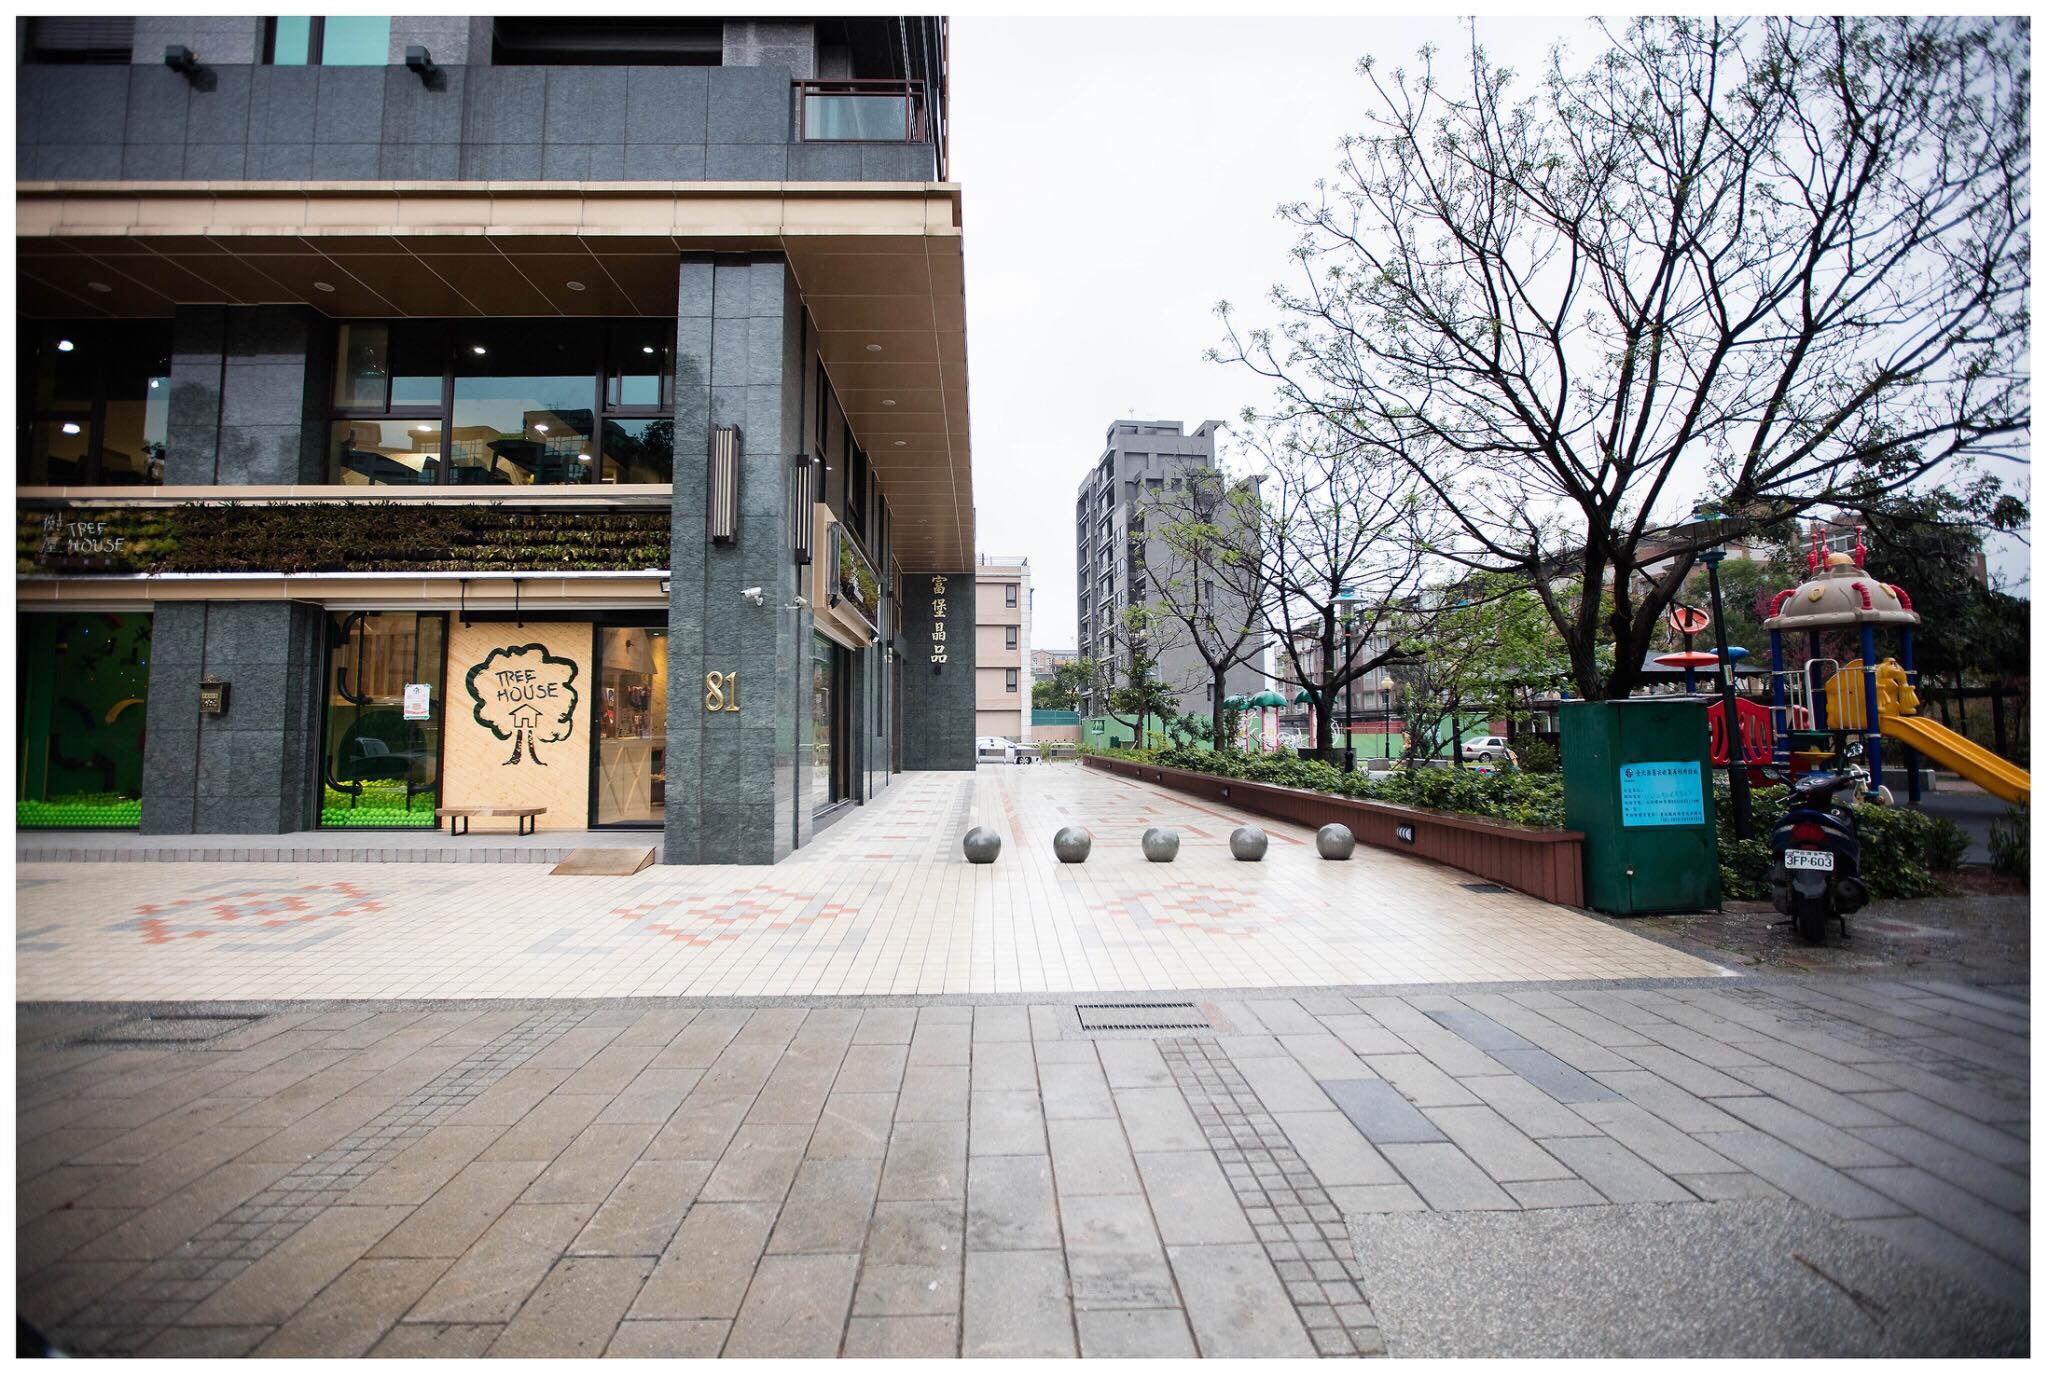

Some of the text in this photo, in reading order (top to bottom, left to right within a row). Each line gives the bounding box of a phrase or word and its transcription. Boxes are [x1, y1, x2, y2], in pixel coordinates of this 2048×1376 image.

[66, 522, 107, 537] TREE
[68, 538, 125, 553] HOUSE
[931, 575, 948, 663] 富堡晶品
[495, 669, 537, 687] TREE
[497, 682, 559, 702] HOUSE
[705, 671, 740, 712] 81
